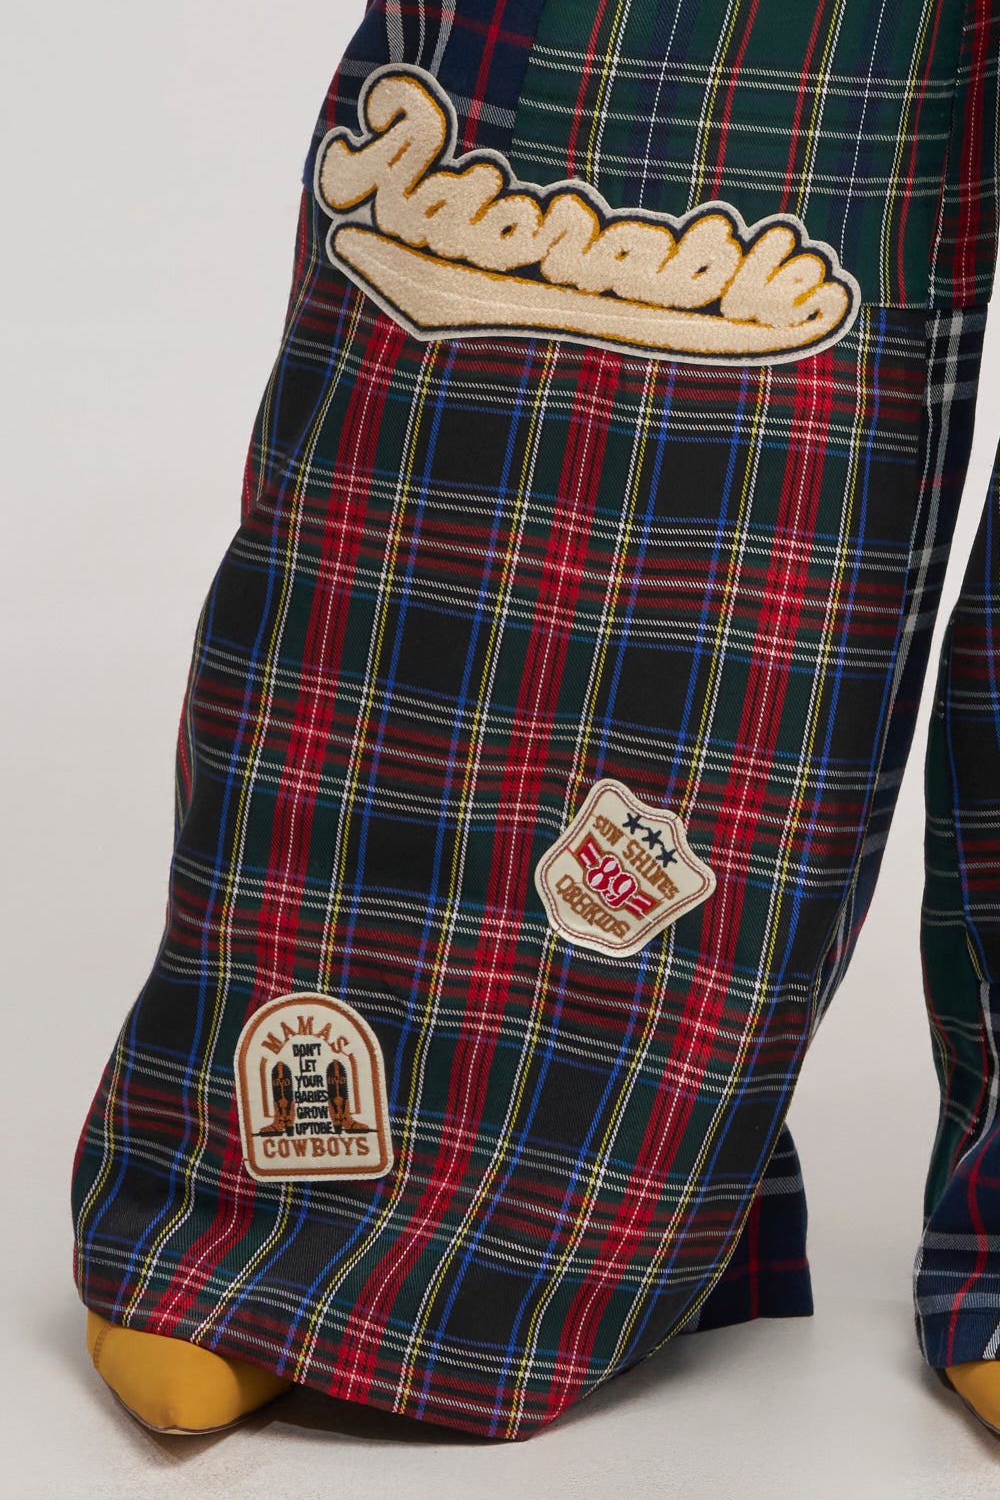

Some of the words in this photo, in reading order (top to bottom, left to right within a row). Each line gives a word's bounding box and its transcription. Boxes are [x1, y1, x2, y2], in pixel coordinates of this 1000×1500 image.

[592, 815, 625, 847] SUN
[622, 839, 681, 901] SHINES
[586, 854, 638, 908] 89
[261, 1015, 350, 1056] MAMAS
[292, 1042, 322, 1058] DON'T
[300, 1059, 317, 1074] LET
[294, 1075, 325, 1089] YOUR
[296, 1105, 330, 1120] GROW
[262, 1136, 370, 1159] COWBOYS
